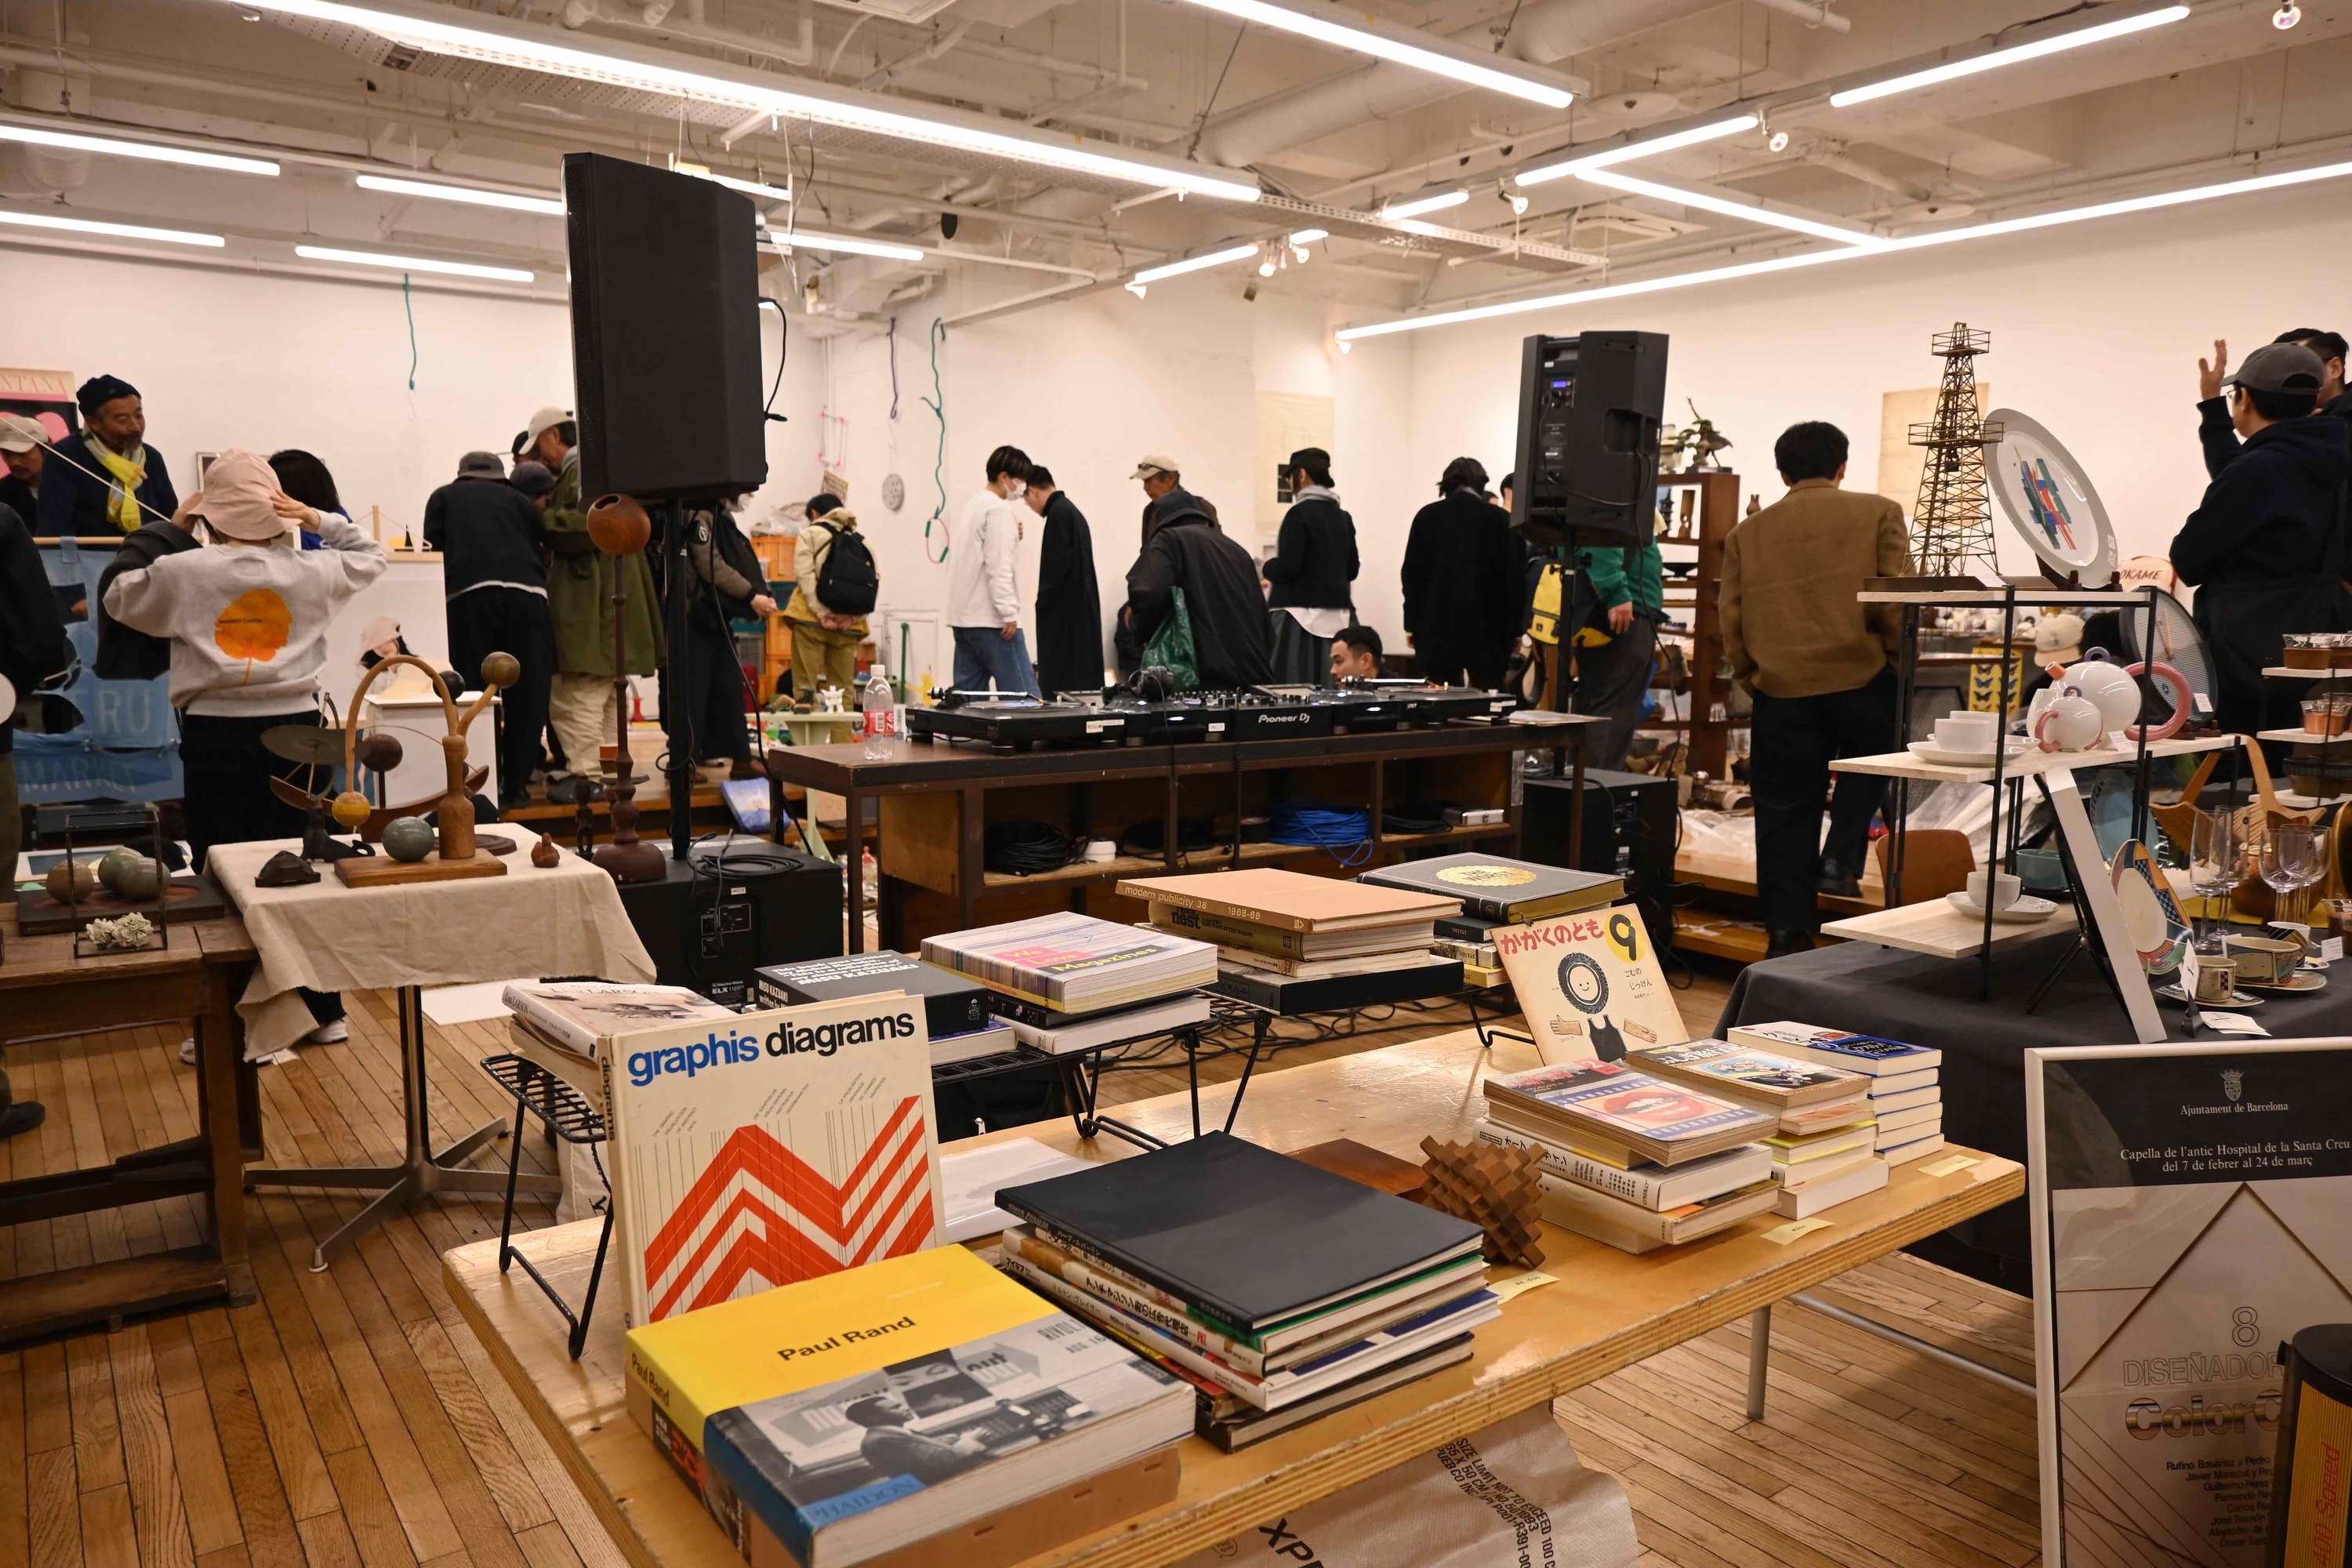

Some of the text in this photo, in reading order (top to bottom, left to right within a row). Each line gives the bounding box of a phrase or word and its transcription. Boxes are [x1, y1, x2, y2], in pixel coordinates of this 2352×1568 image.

[1258, 714, 1297, 724] Pioneer
[1125, 886, 1261, 920] modern publicity 38 1968-69
[1501, 918, 1605, 956] かがくのとも
[1610, 913, 1637, 961] 9
[1005, 949, 1044, 959] We
[1028, 953, 1081, 965] Love
[1051, 948, 1157, 971] Magazines
[797, 973, 842, 985] MISU
[845, 964, 920, 979] KAZUAKI
[759, 980, 789, 1004] MISU KAZUAKI
[997, 985, 1018, 996] Magazines
[512, 995, 529, 1014] LARSON
[628, 1013, 915, 1087] graphis diagrams
[601, 1056, 615, 1141] diagrams
[2180, 1102, 2288, 1117] Ajuntament de Barcelona
[2120, 1138, 2350, 1161] Capella de l'antic Hospital de la Santa Creu
[2162, 1155, 2313, 1172] del 7 de febrer al 24 de març
[1109, 1315, 1126, 1328] Milton
[2231, 1306, 2260, 1348] 8
[777, 1316, 916, 1361] Paul Rand
[632, 1353, 649, 1385] Paul
[649, 1374, 670, 1406] Rand
[2166, 1461, 2194, 1471] Rufino
[2245, 1456, 2270, 1465] Pedro
[1454, 1456, 1467, 1465] X
[1462, 1467, 1477, 1479] 50
[1472, 1478, 1490, 1494] CM
[2185, 1472, 2211, 1482] Javier
[2213, 1469, 2250, 1480] Mariscal
[2204, 1480, 2244, 1491] Guillermo
[2315, 1443, 2342, 1519] Speed
[1457, 1438, 1478, 1459] SIZE
[1472, 1458, 1497, 1483] LIMIT
[1492, 1482, 1514, 1494] NOT
[1510, 1494, 1526, 1504] TO
[1524, 1503, 1552, 1535] EXCEED
[1542, 1537, 1554, 1559] 100
[2215, 1493, 2256, 1502] Fernando
[2226, 1504, 2255, 1513] Carlos
[2209, 1527, 2249, 1537] Alejandro
[2313, 1523, 2334, 1568] 400
